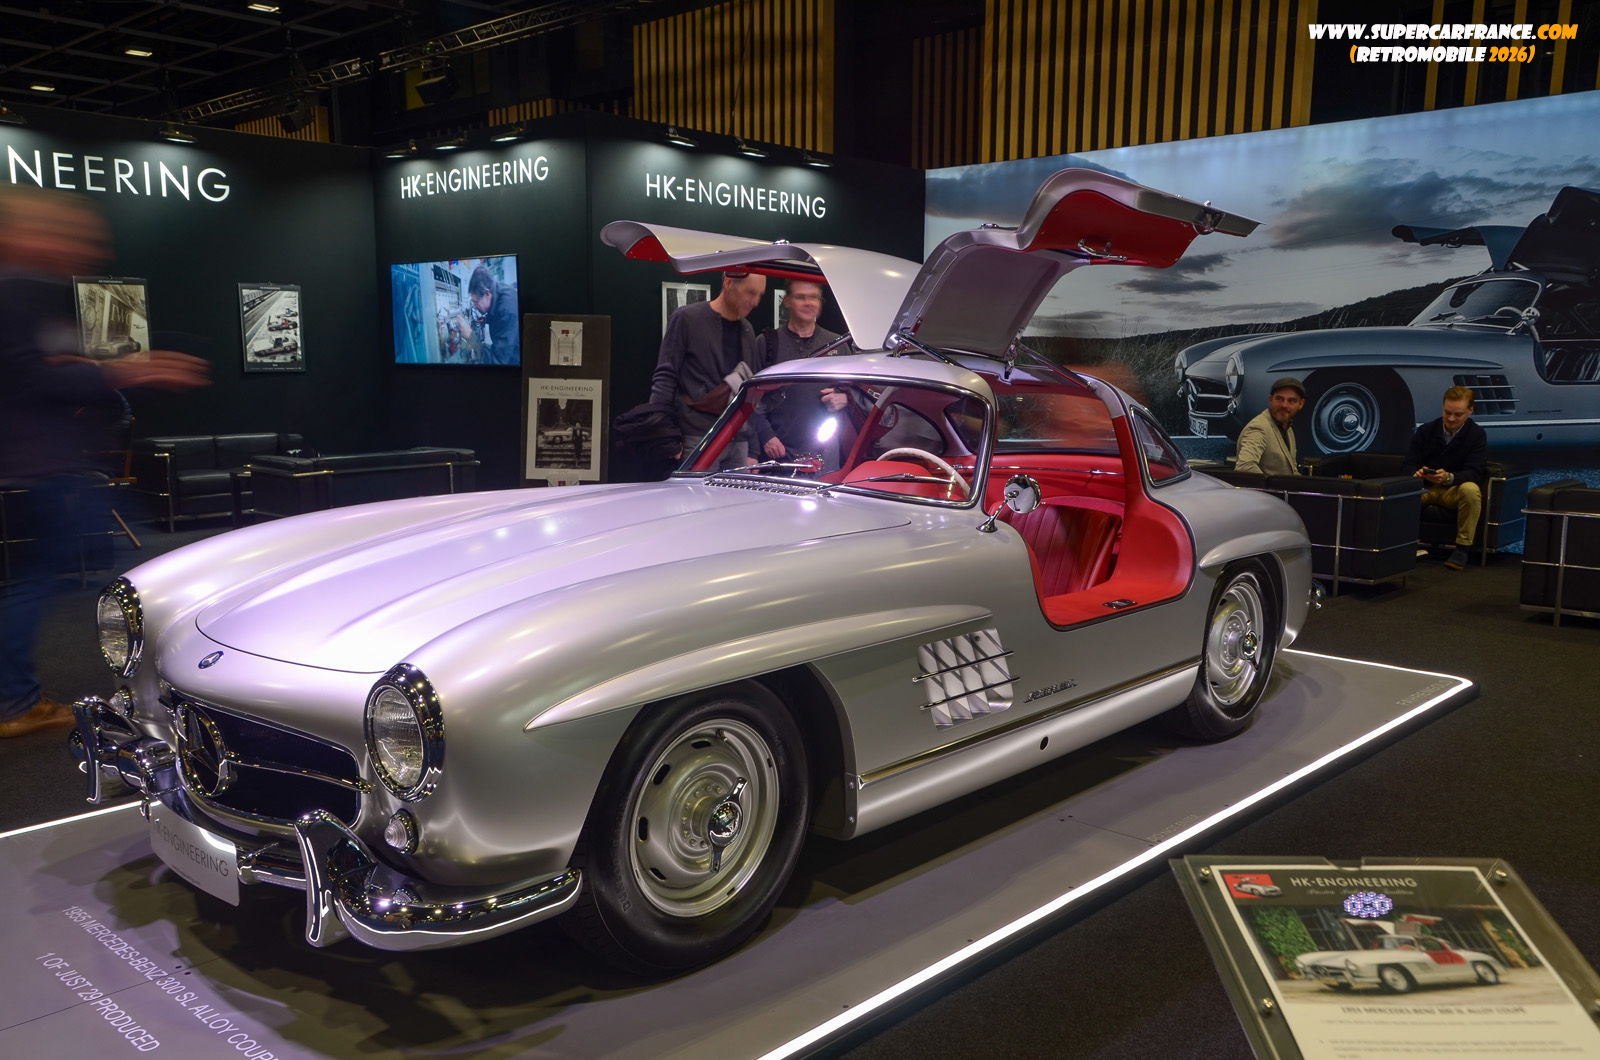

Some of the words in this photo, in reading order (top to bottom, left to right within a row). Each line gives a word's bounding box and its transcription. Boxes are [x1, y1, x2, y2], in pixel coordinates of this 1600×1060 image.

[400, 155, 549, 200] HK-ENGINEERING
[645, 172, 827, 219] HK-ENGINEERING
[1289, 877, 1418, 888] HK-ENGINEERING
[43, 957, 70, 970] OF
[55, 969, 93, 990] JUST
[62, 905, 92, 923] 1955
[79, 919, 168, 981] MERCEDES-BENZ
[155, 977, 186, 994] 300
[175, 991, 199, 1007] SL
[187, 1004, 240, 1034] ALLOY
[226, 1032, 280, 1060] COUP
[77, 988, 103, 1001] 29
[90, 997, 161, 1052] PRODUCED
